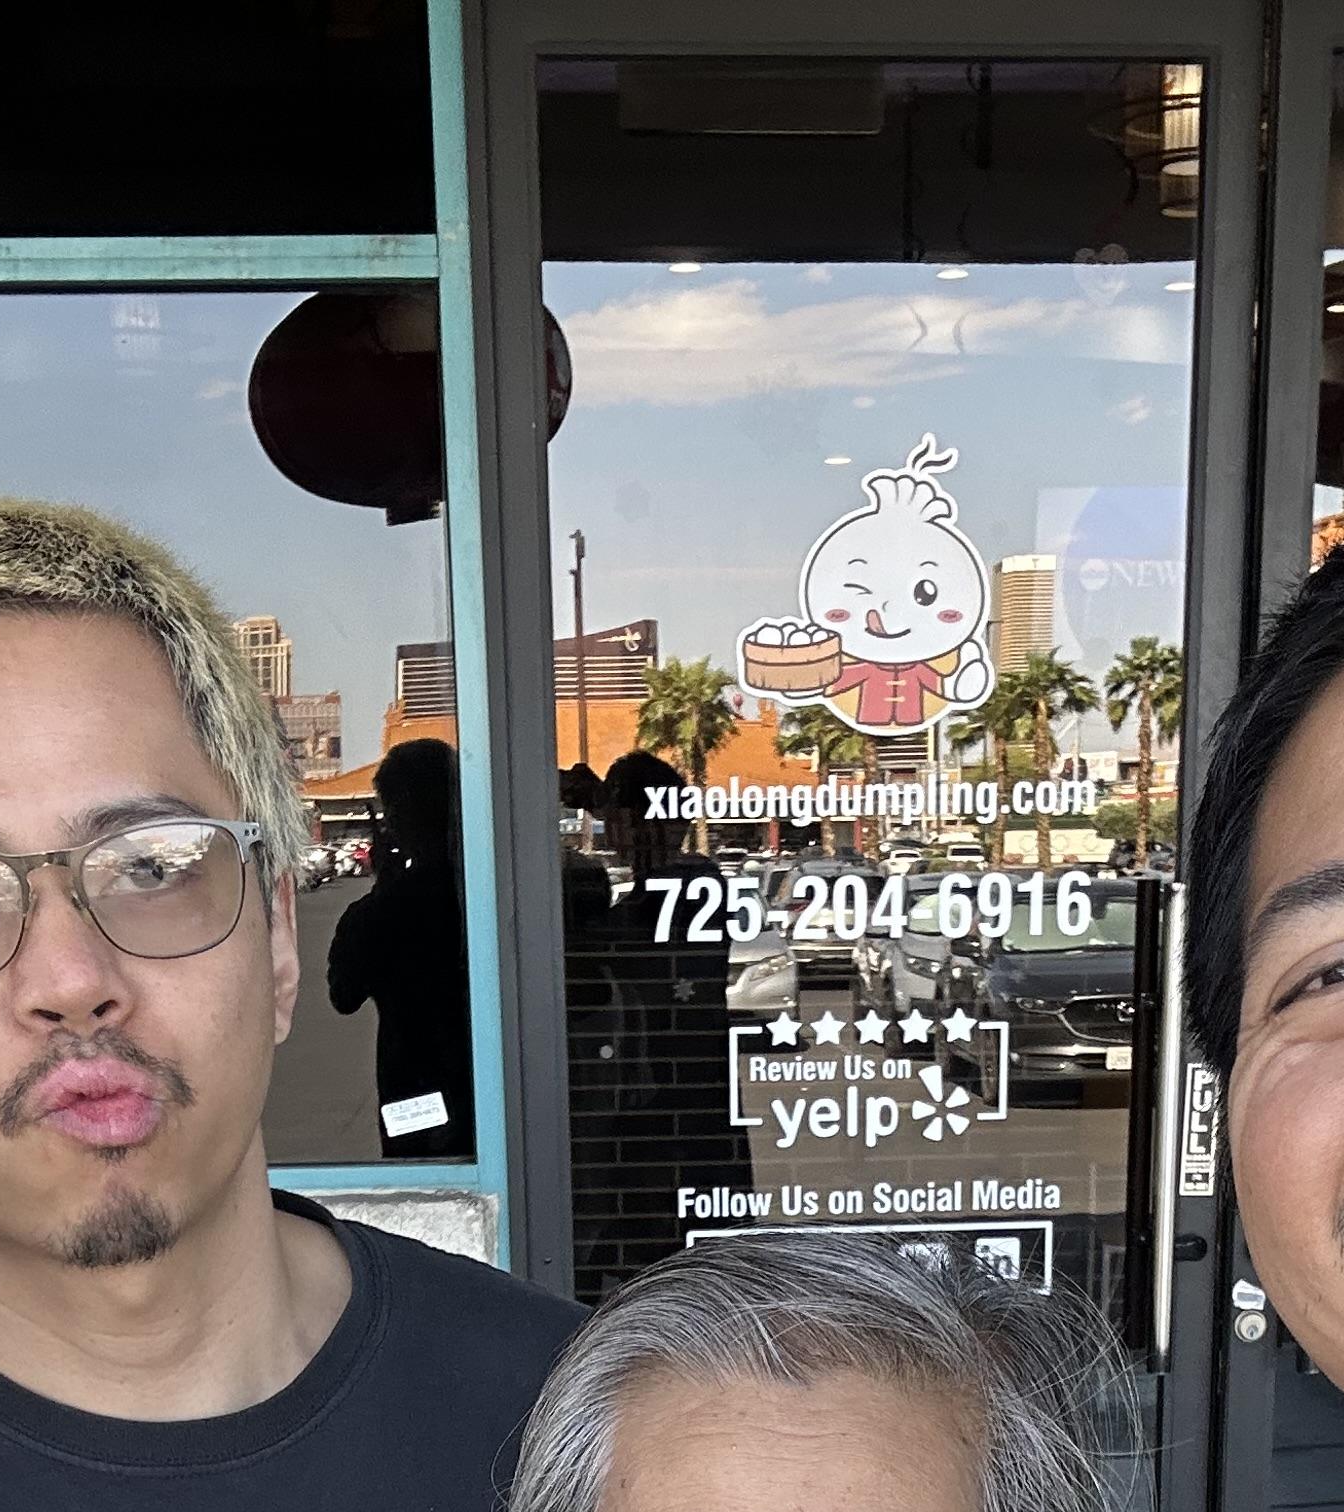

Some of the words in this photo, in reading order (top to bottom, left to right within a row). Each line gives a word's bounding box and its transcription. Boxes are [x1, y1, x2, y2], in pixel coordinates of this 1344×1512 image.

[643, 774, 1097, 827] xiaolongdumpling.com
[644, 871, 1093, 943] 725-204-6916
[749, 1056, 837, 1082] Review
[844, 1055, 876, 1080] Us
[882, 1059, 912, 1080] on
[771, 1086, 899, 1148] yelp
[1188, 1068, 1214, 1155] PULL
[677, 1187, 772, 1219] Follow
[781, 1185, 819, 1216] Us
[828, 1189, 864, 1214] on
[872, 1181, 962, 1215] Social
[972, 1178, 1061, 1212] Media
